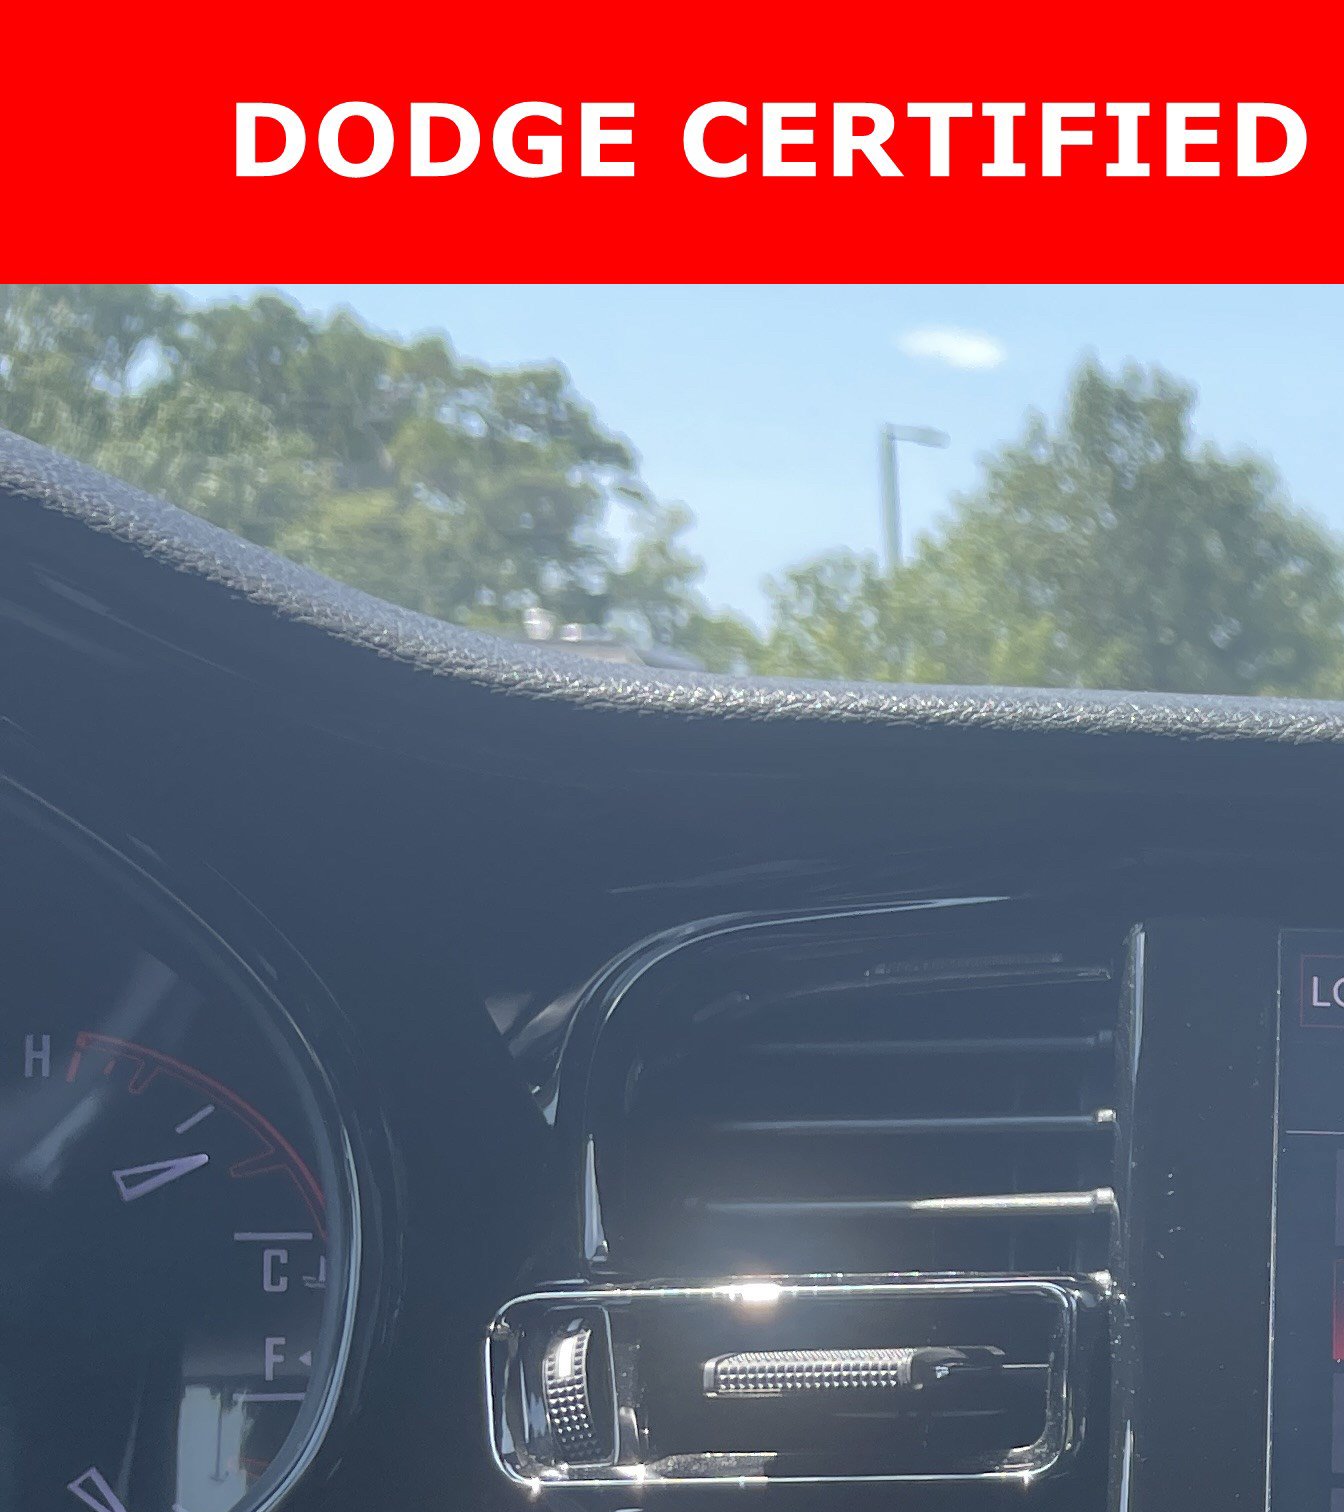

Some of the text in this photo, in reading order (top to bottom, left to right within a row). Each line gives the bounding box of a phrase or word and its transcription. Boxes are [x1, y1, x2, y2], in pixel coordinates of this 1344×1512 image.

[23, 1033, 52, 1078] H
[261, 1248, 290, 1293] C
[263, 1335, 288, 1382] F
